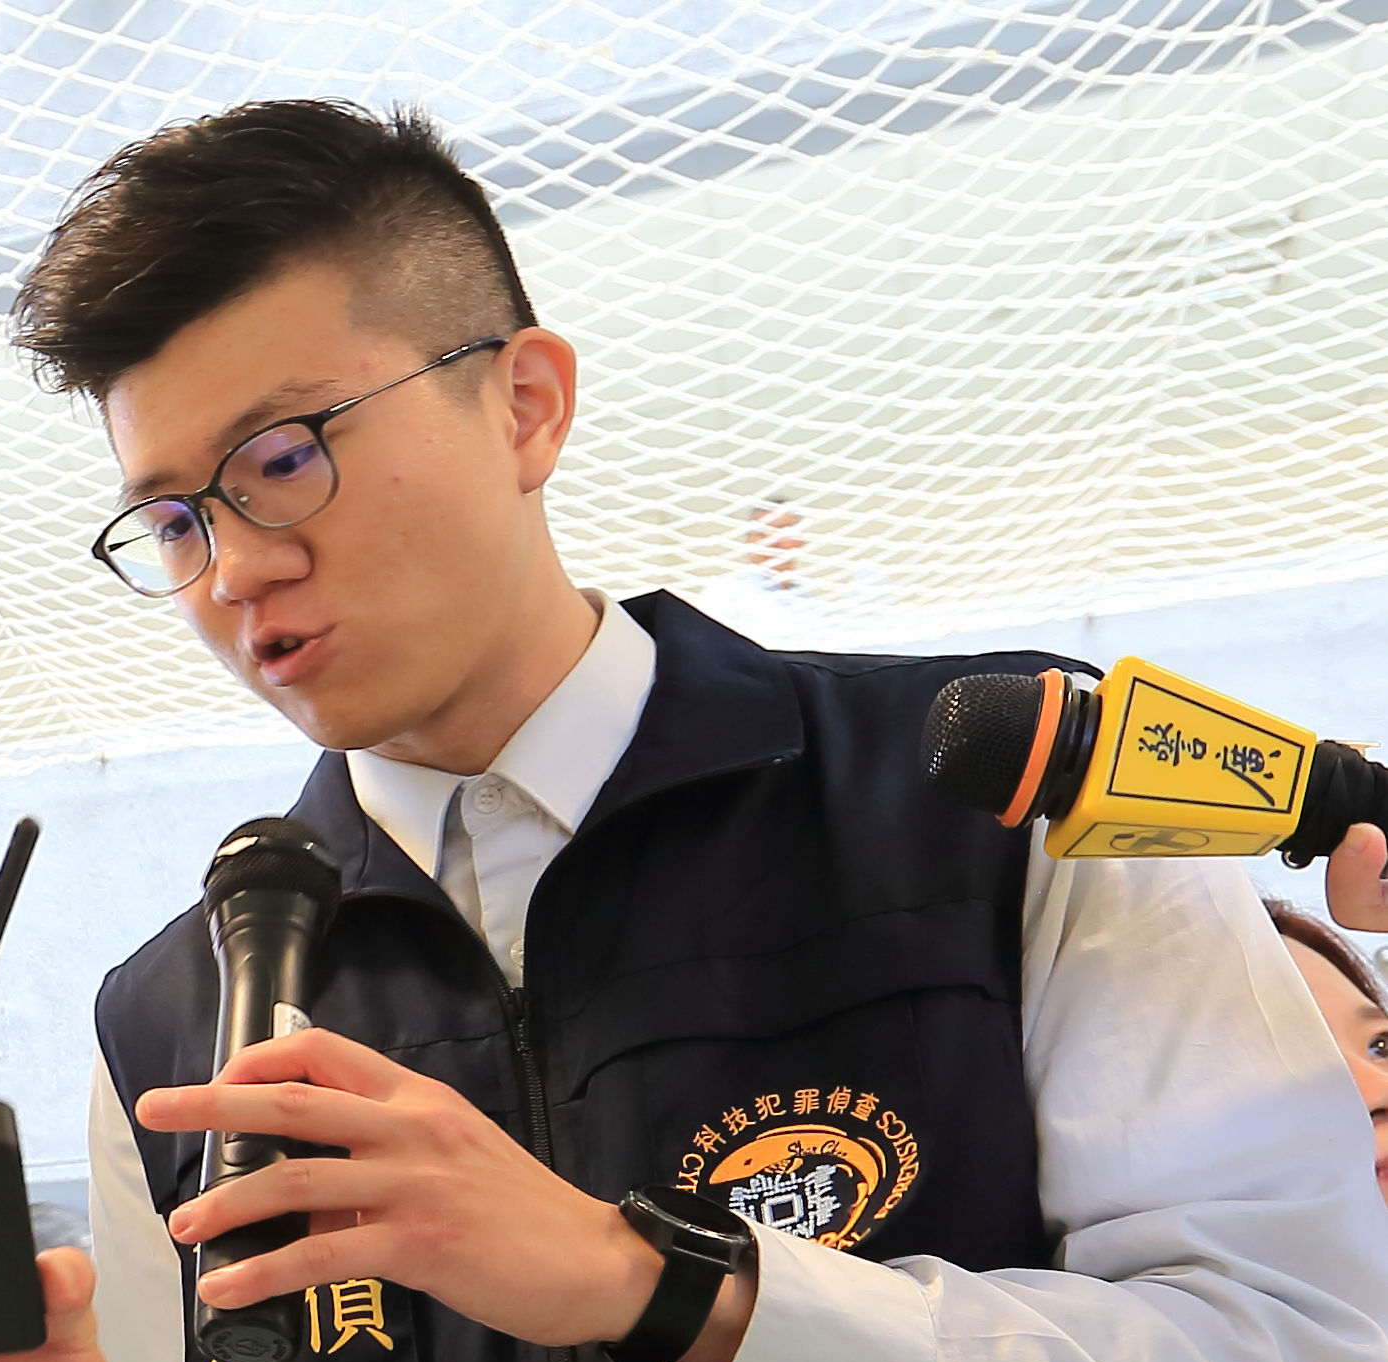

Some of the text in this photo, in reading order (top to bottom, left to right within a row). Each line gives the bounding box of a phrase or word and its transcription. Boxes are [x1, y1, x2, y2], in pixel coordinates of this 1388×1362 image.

[692, 1086, 880, 1153] 科技犯罪偵查
